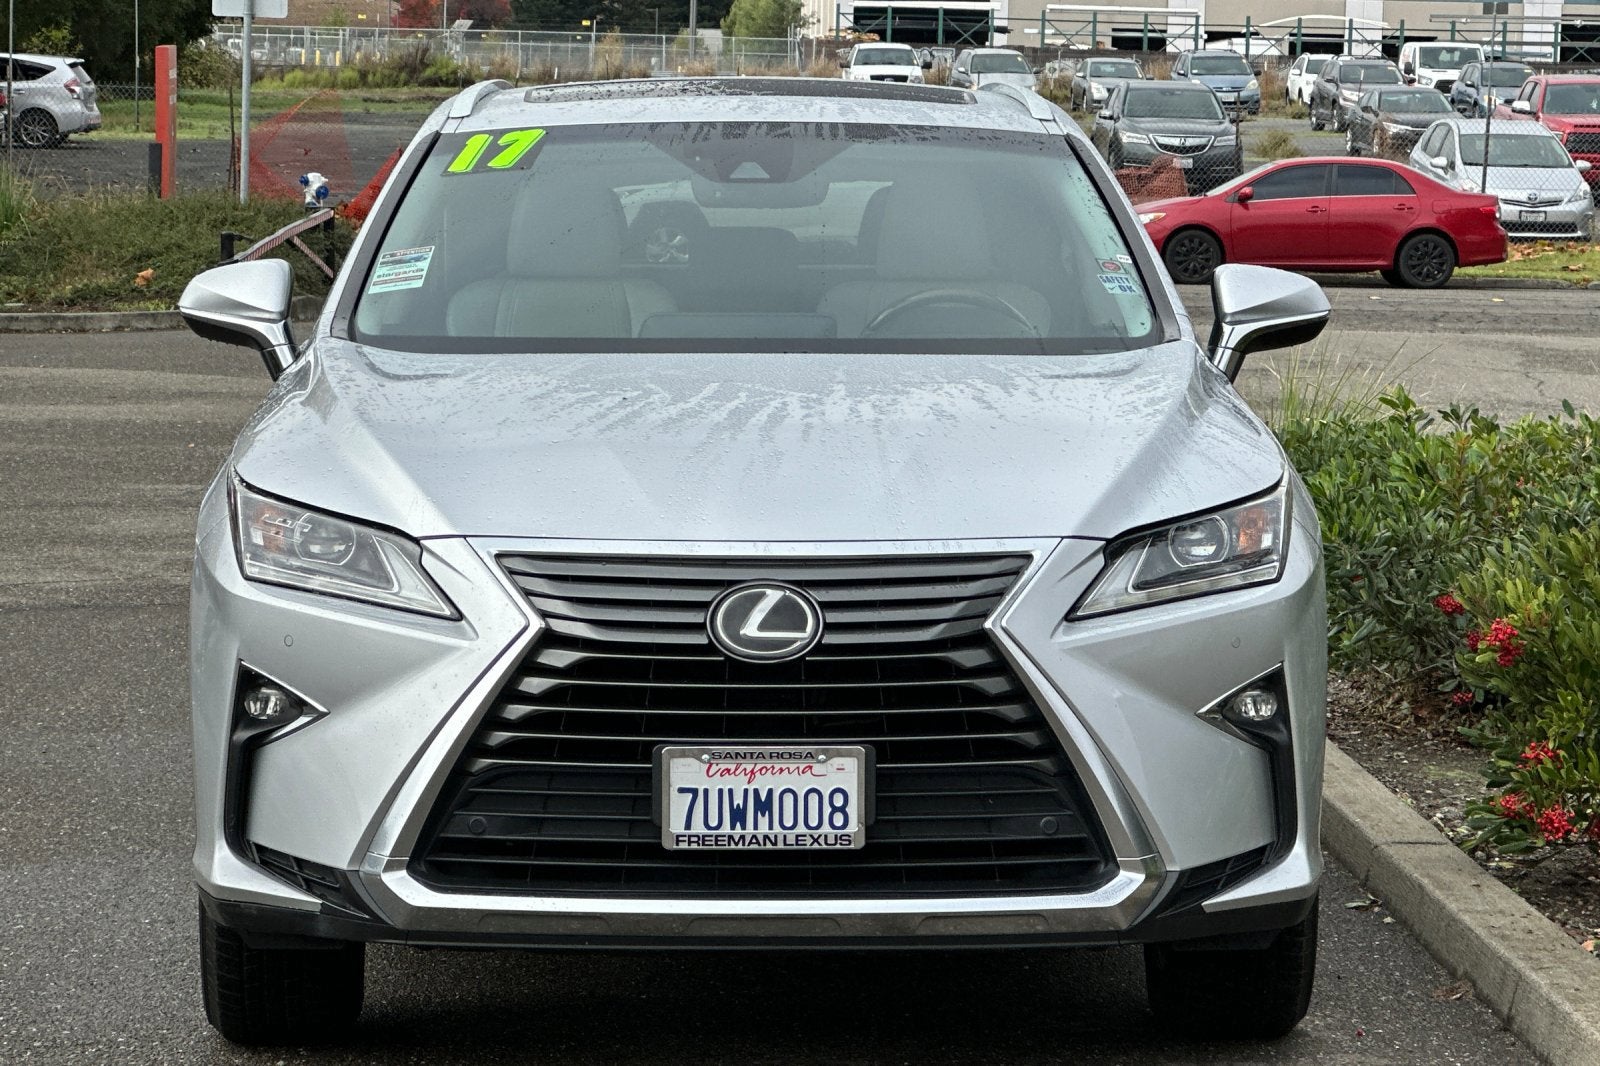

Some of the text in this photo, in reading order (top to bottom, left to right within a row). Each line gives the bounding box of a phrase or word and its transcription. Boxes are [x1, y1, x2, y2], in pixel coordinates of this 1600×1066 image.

[448, 129, 546, 172] 17
[1099, 275, 1131, 284] SAFETY
[1119, 284, 1136, 293] OK
[711, 751, 815, 760] SANTA ROSA
[705, 763, 827, 784] California
[677, 787, 850, 831] 7UWM008
[675, 834, 852, 847] FREEMAN LEXUS
